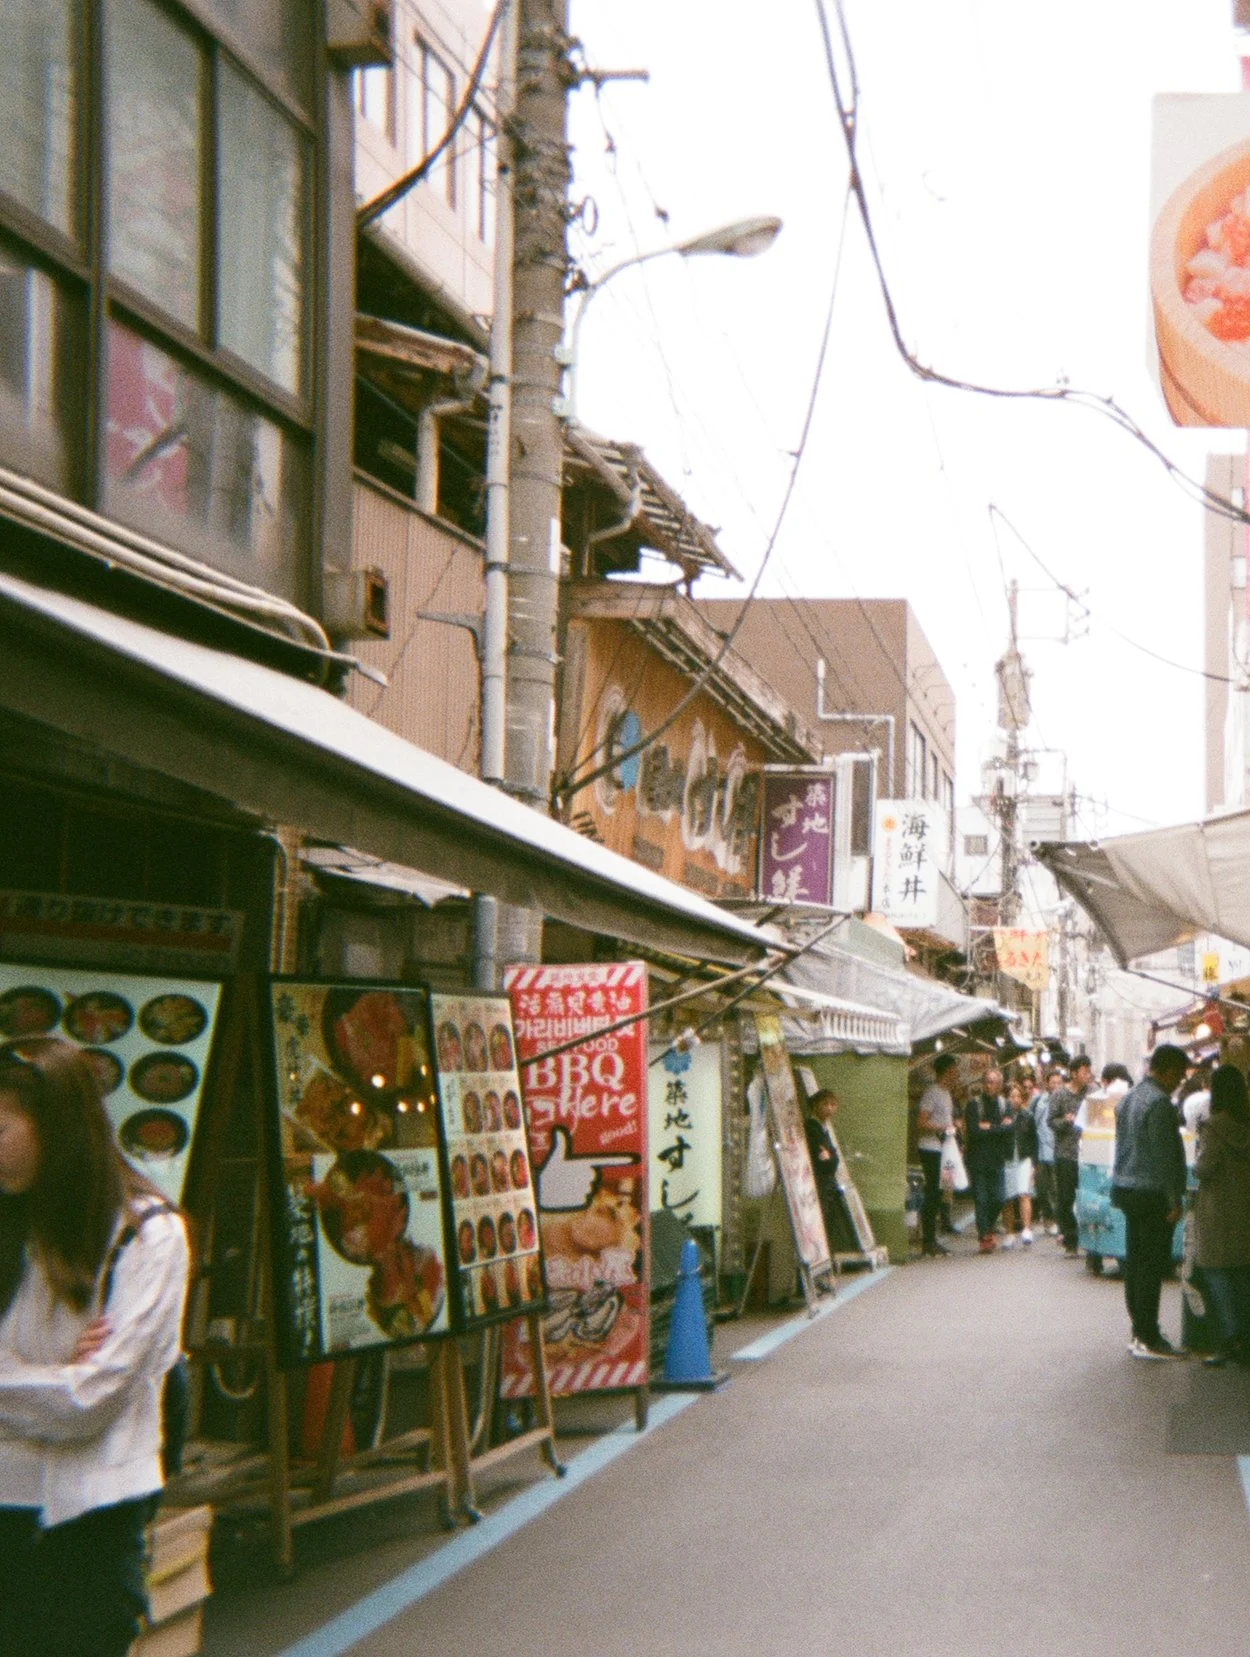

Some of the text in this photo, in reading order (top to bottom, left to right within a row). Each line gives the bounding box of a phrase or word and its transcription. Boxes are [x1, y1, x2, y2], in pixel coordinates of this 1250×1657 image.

[898, 812, 930, 904] 海鮮丼
[526, 1051, 626, 1092] BBQ
